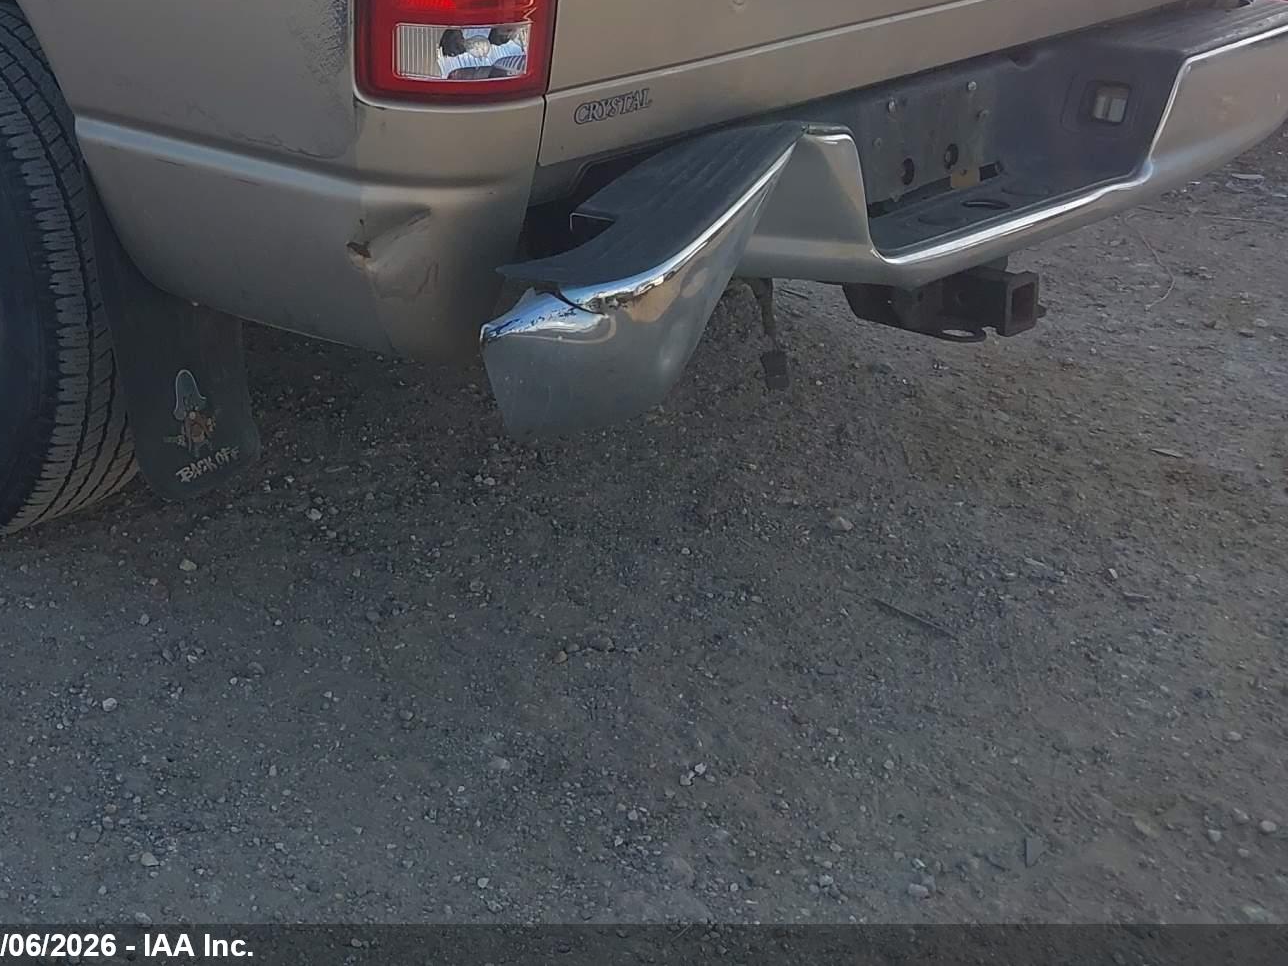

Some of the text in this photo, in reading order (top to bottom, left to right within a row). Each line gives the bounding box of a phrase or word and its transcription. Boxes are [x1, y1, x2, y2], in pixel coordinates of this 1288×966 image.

[574, 87, 653, 125] CRYSTAL
[175, 446, 240, 482] BACK OFF
